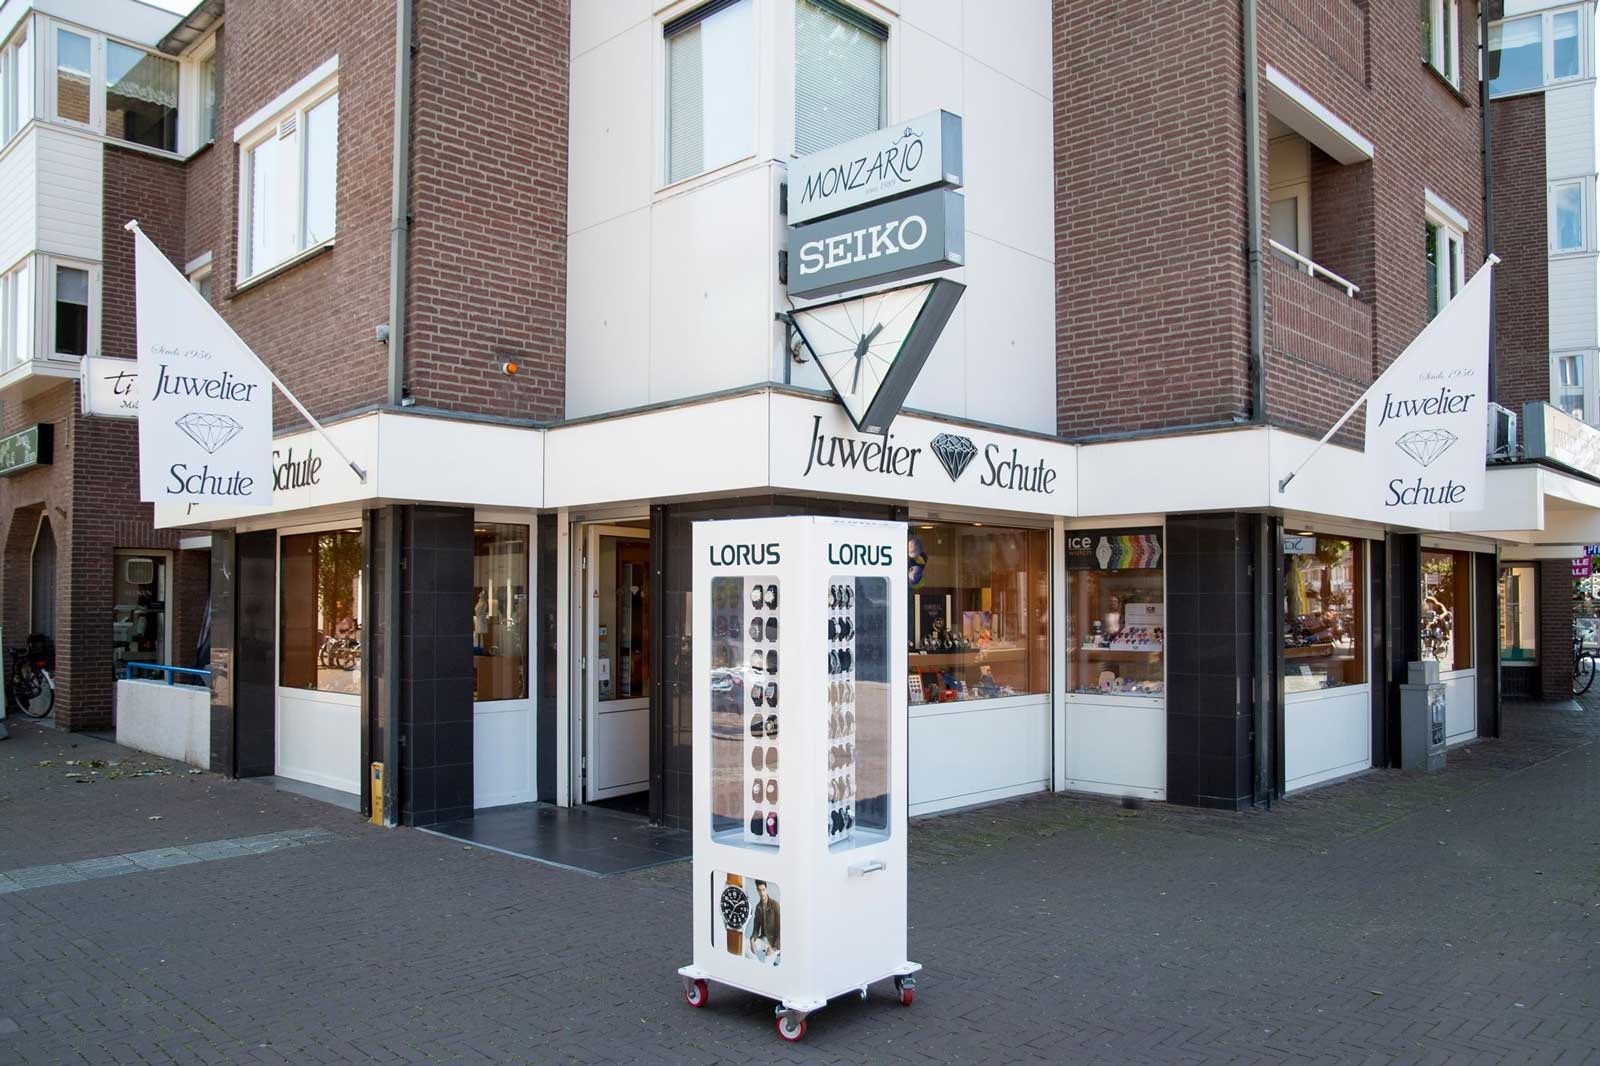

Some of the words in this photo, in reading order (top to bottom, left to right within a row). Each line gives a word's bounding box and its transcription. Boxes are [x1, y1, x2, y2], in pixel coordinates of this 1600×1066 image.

[801, 139, 923, 204] MONZARIO
[800, 215, 927, 275] SEIKO
[152, 364, 258, 402] Juwelier
[1378, 386, 1476, 428] Juwelier
[273, 447, 322, 492] Schute
[803, 415, 921, 477] Juwelier
[980, 443, 1057, 494] Schute
[166, 463, 254, 496] Schute
[1384, 477, 1467, 507] Schute
[709, 543, 781, 566] LORUS
[828, 543, 893, 566] LORUS
